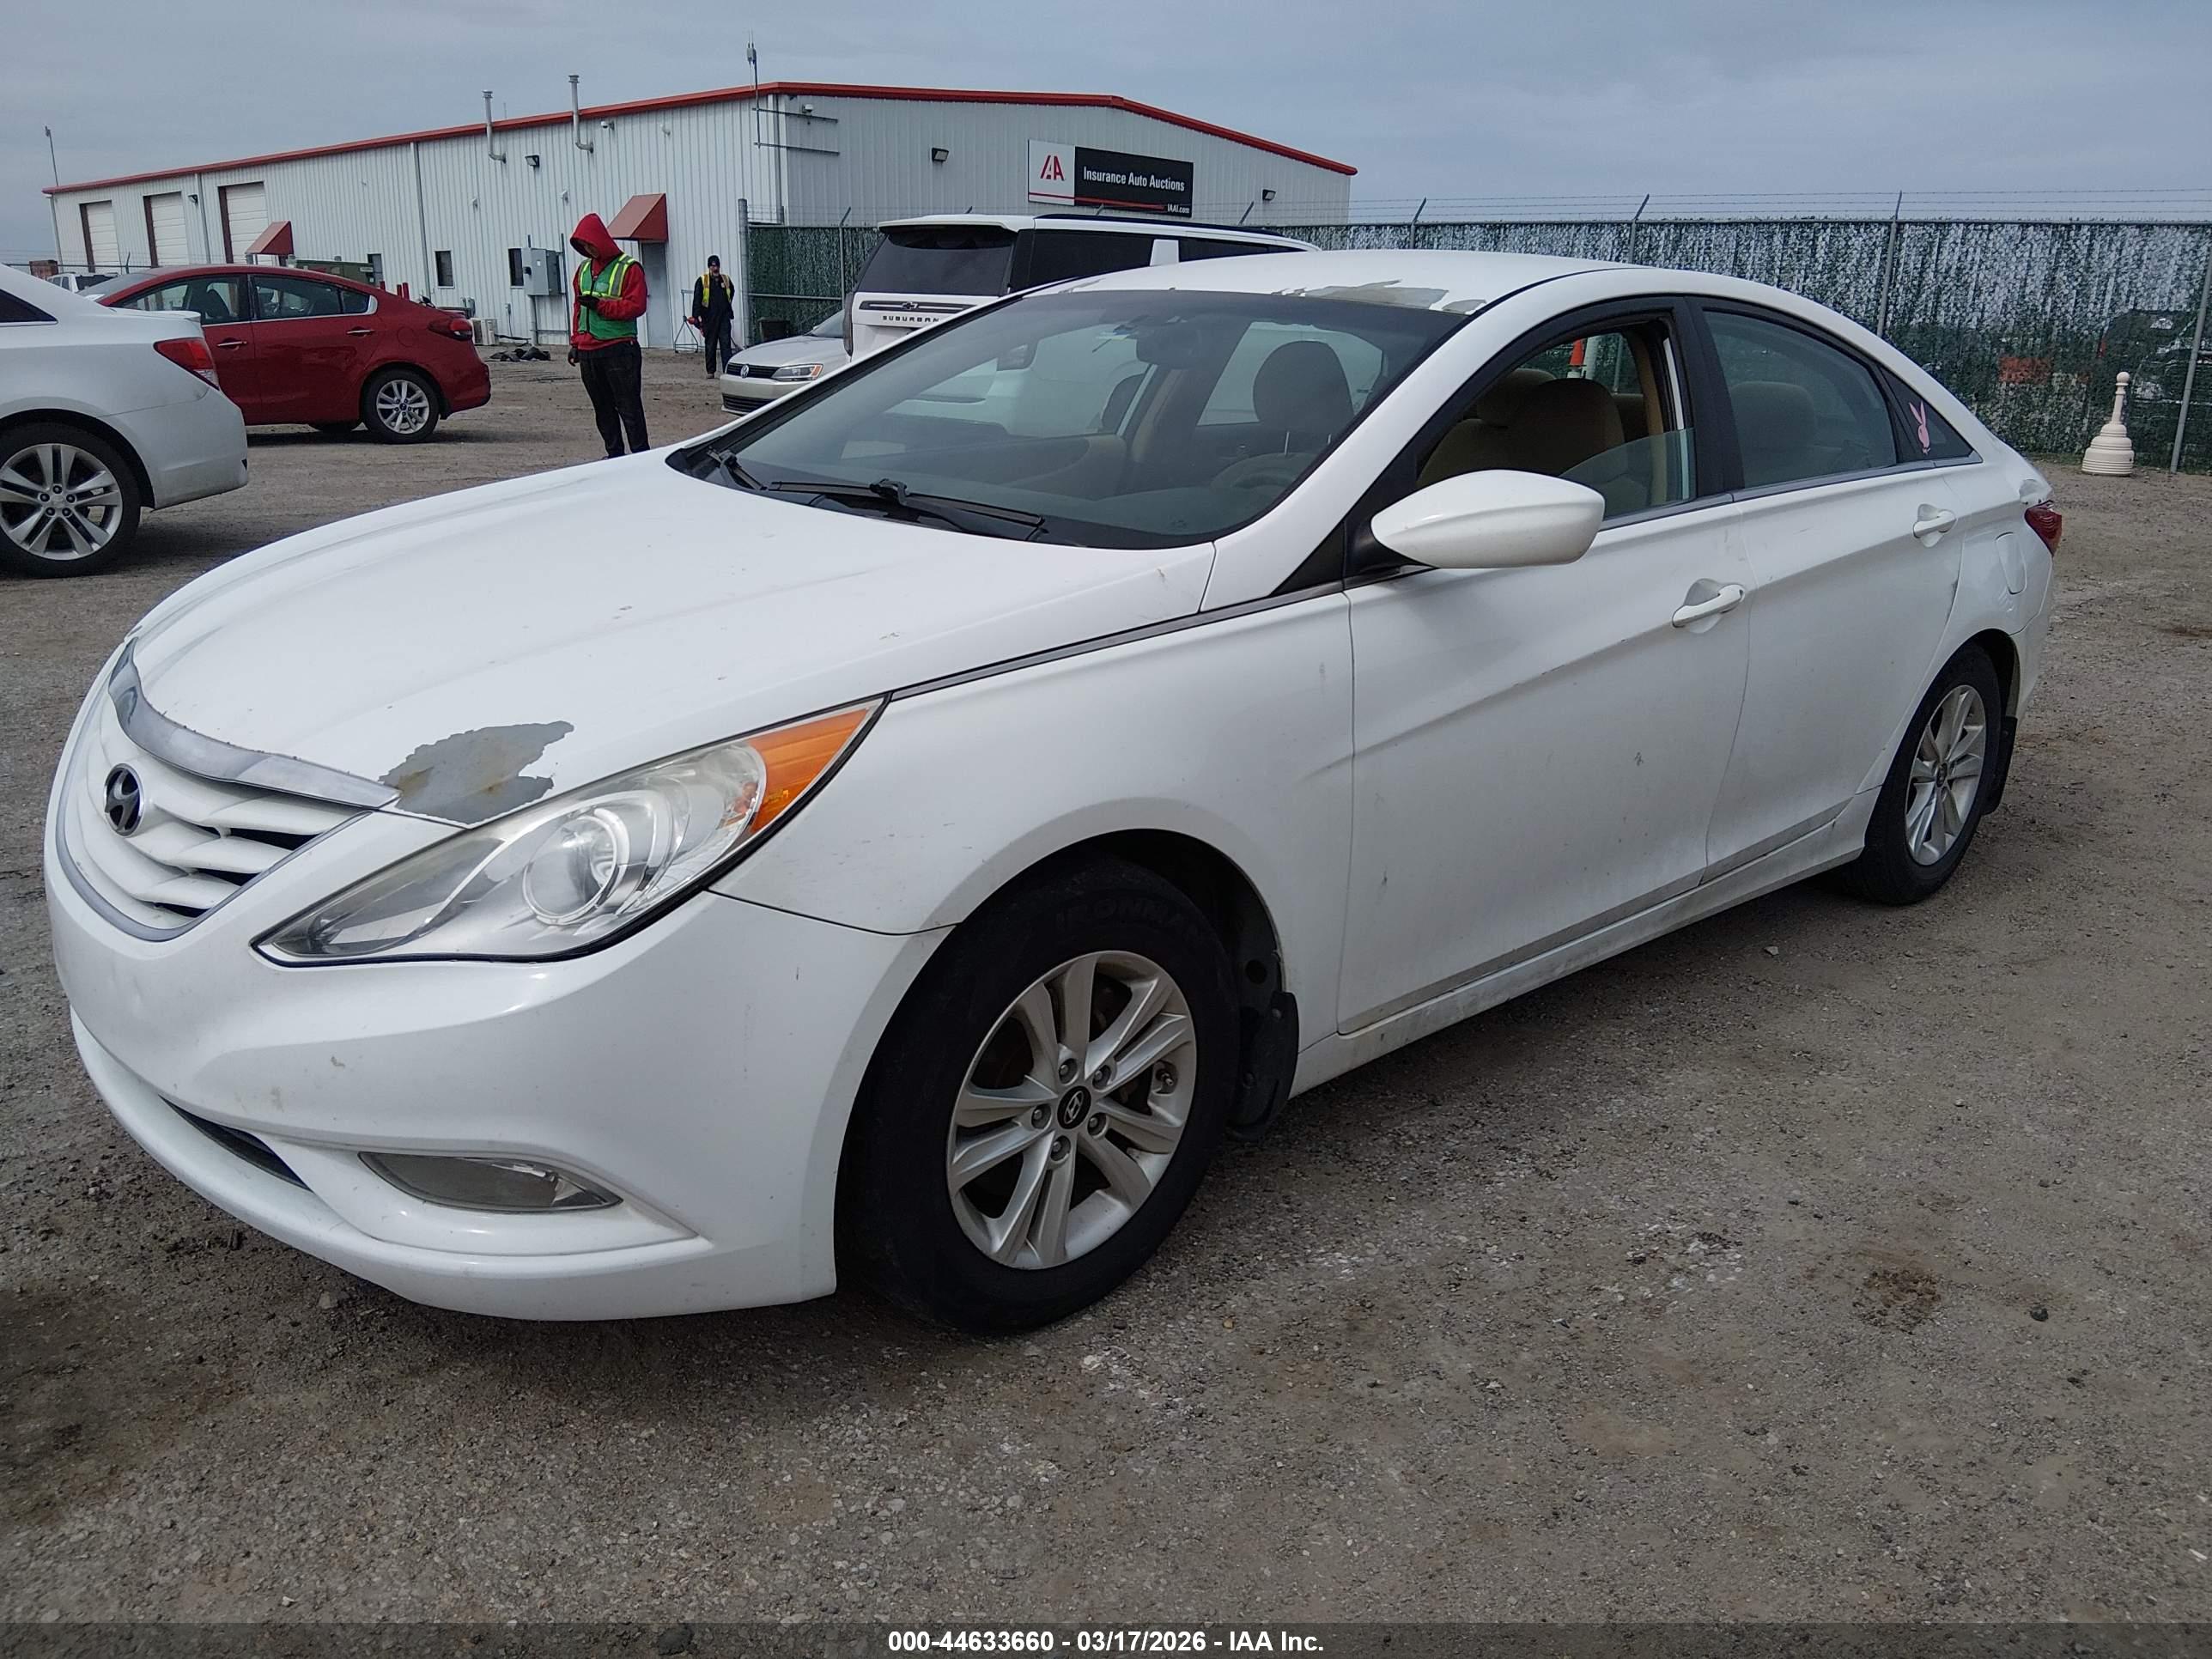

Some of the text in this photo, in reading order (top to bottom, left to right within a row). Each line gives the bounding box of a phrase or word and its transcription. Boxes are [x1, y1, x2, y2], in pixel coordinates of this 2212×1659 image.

[1083, 166, 1185, 191] Insurance Auto Auctions
